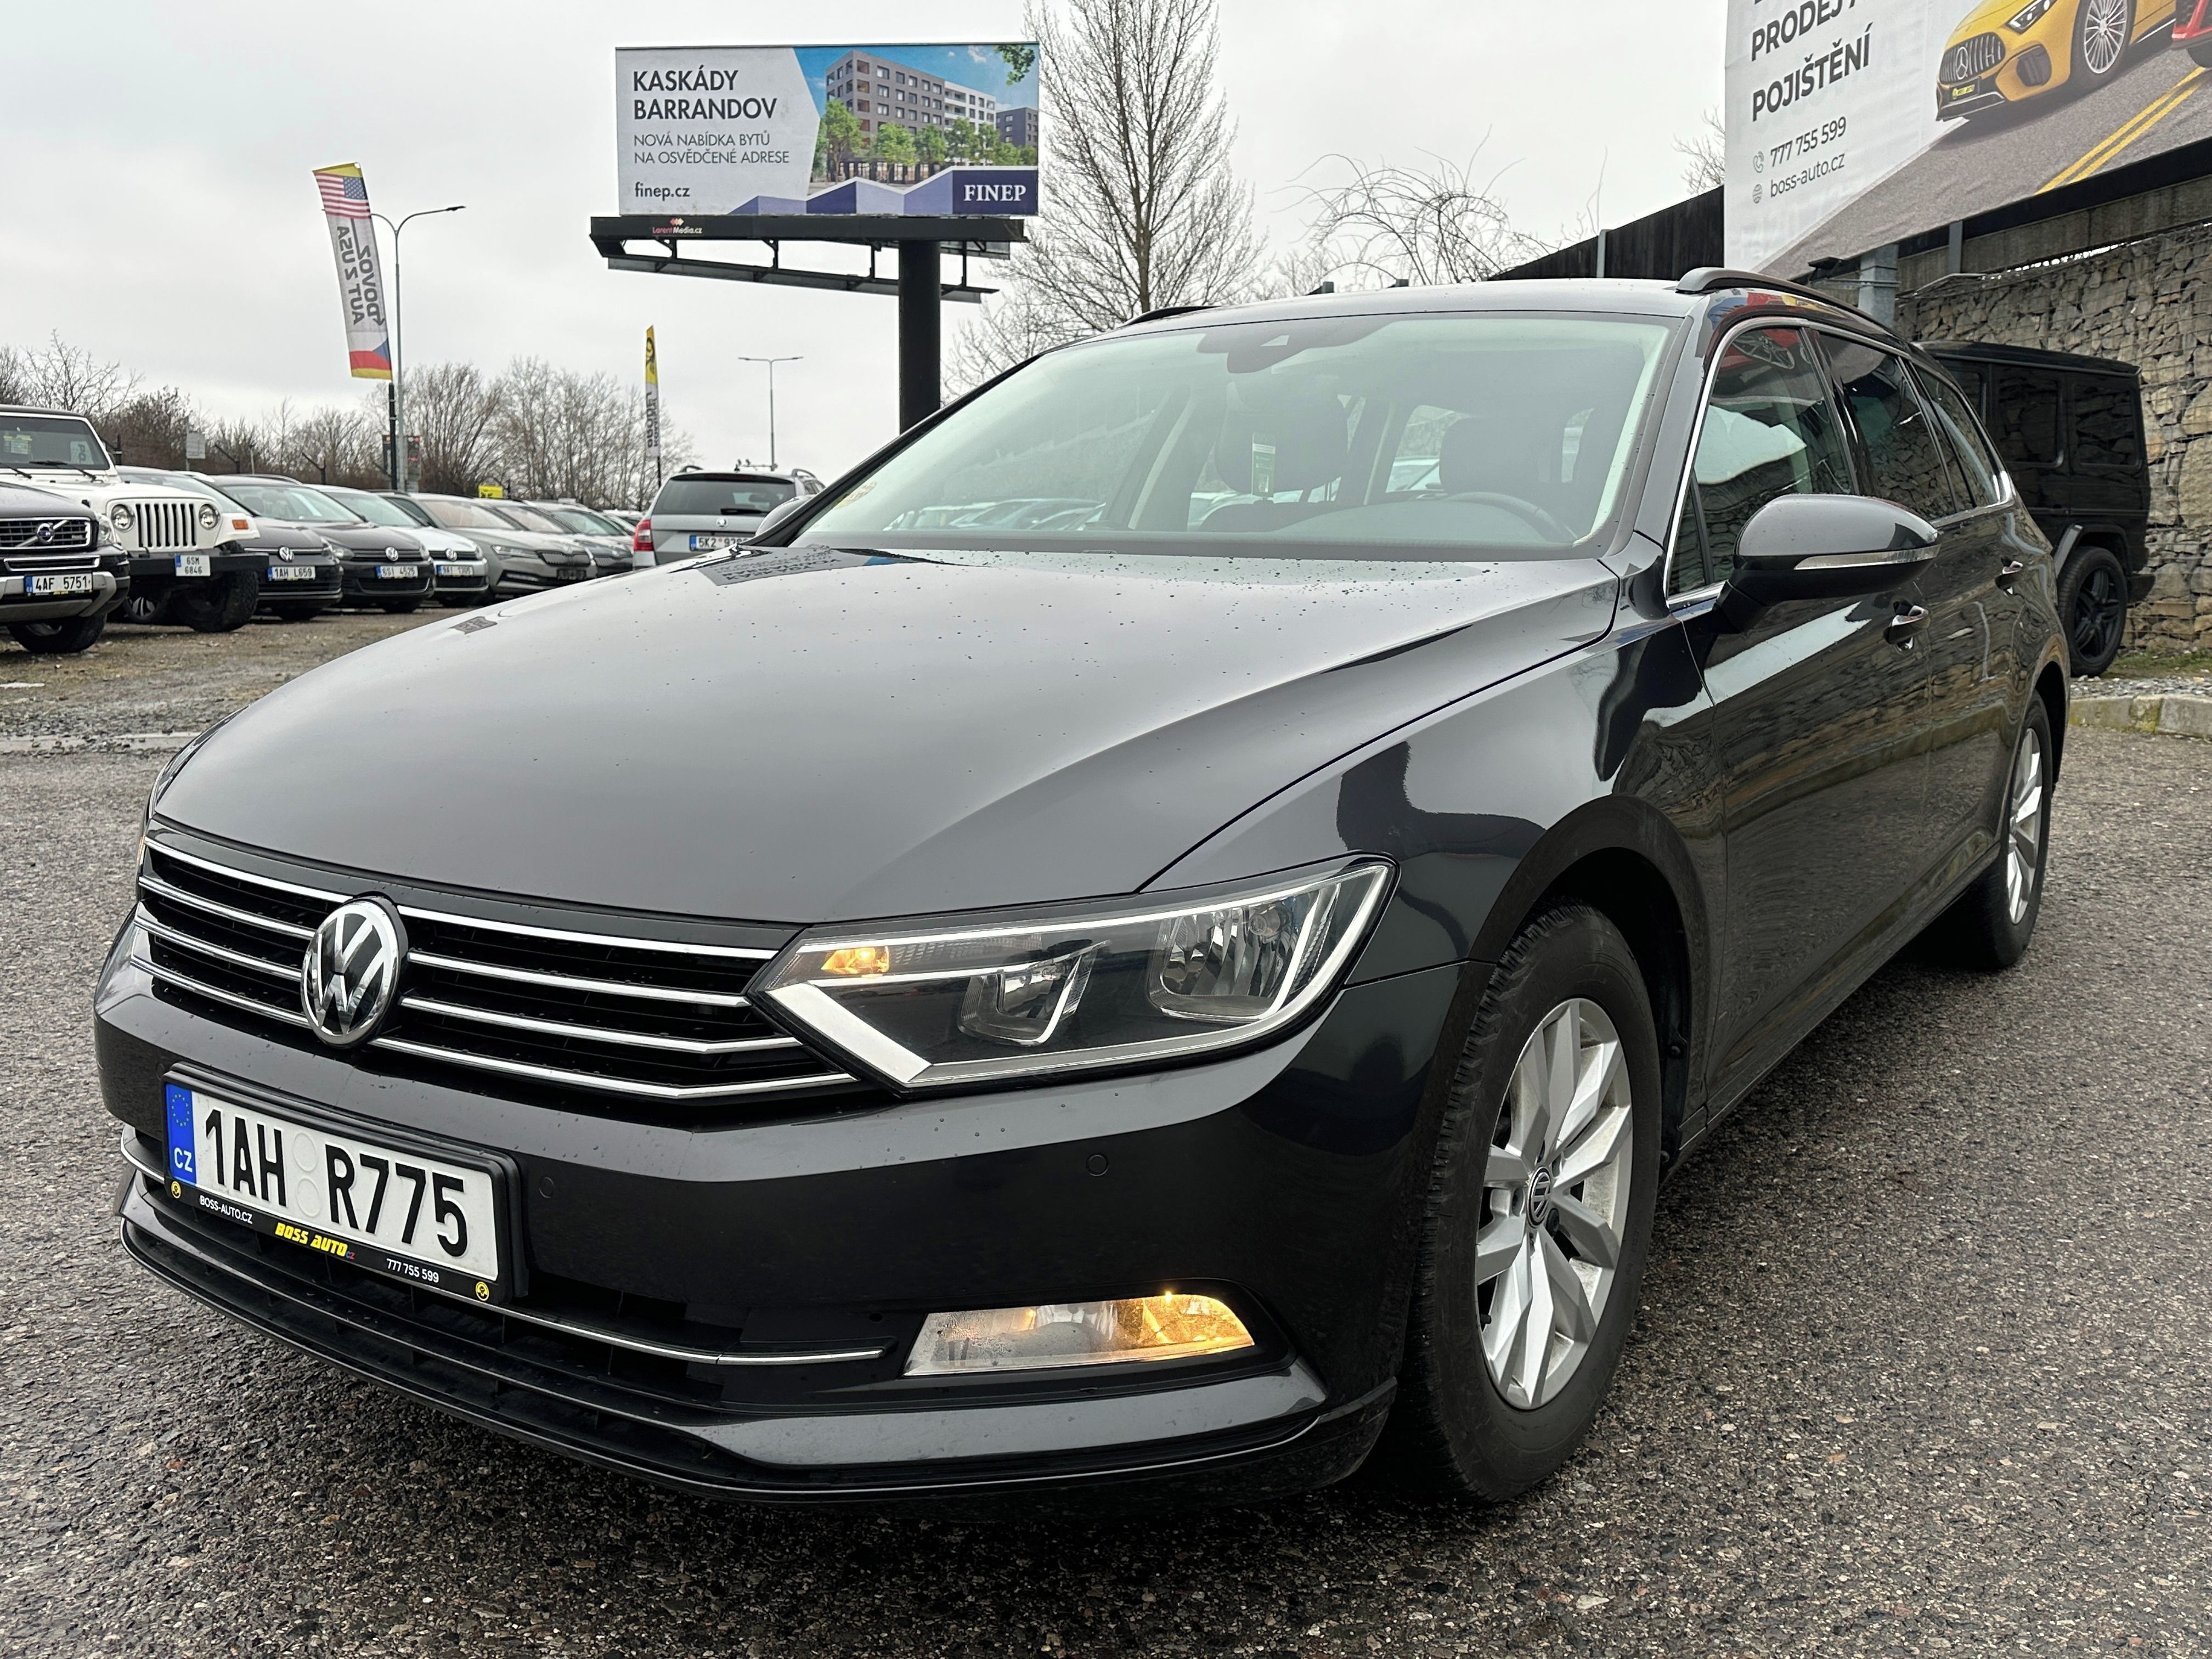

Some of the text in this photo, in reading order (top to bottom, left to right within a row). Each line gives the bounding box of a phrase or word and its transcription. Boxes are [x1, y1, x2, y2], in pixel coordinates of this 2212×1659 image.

[1751, 0, 1843, 62] PRODEJ
[633, 64, 739, 92] KASKÁDY
[1752, 22, 1874, 122] POJIŠTĚNÍ
[634, 98, 777, 120] BARRANDOV
[634, 129, 770, 146] NOVÁ NABÍDKA BYTŮ
[1770, 116, 1847, 167] 777 755 599
[634, 148, 790, 164] NA OSVĚDČENÉ ADRESE
[1770, 153, 1846, 198] boss-auto.cz
[635, 182, 691, 201] finep.cz
[963, 184, 1027, 202] FINEP
[36, 575, 87, 591] 4AF 5751
[174, 1147, 193, 1173] CZ
[205, 1109, 468, 1257] 1AH R775
[199, 1194, 253, 1224] BOSS-AUTO.CZ
[275, 1222, 309, 1245] BOSS
[310, 1234, 348, 1257] AUTO
[386, 1258, 439, 1284] 777 755 599
